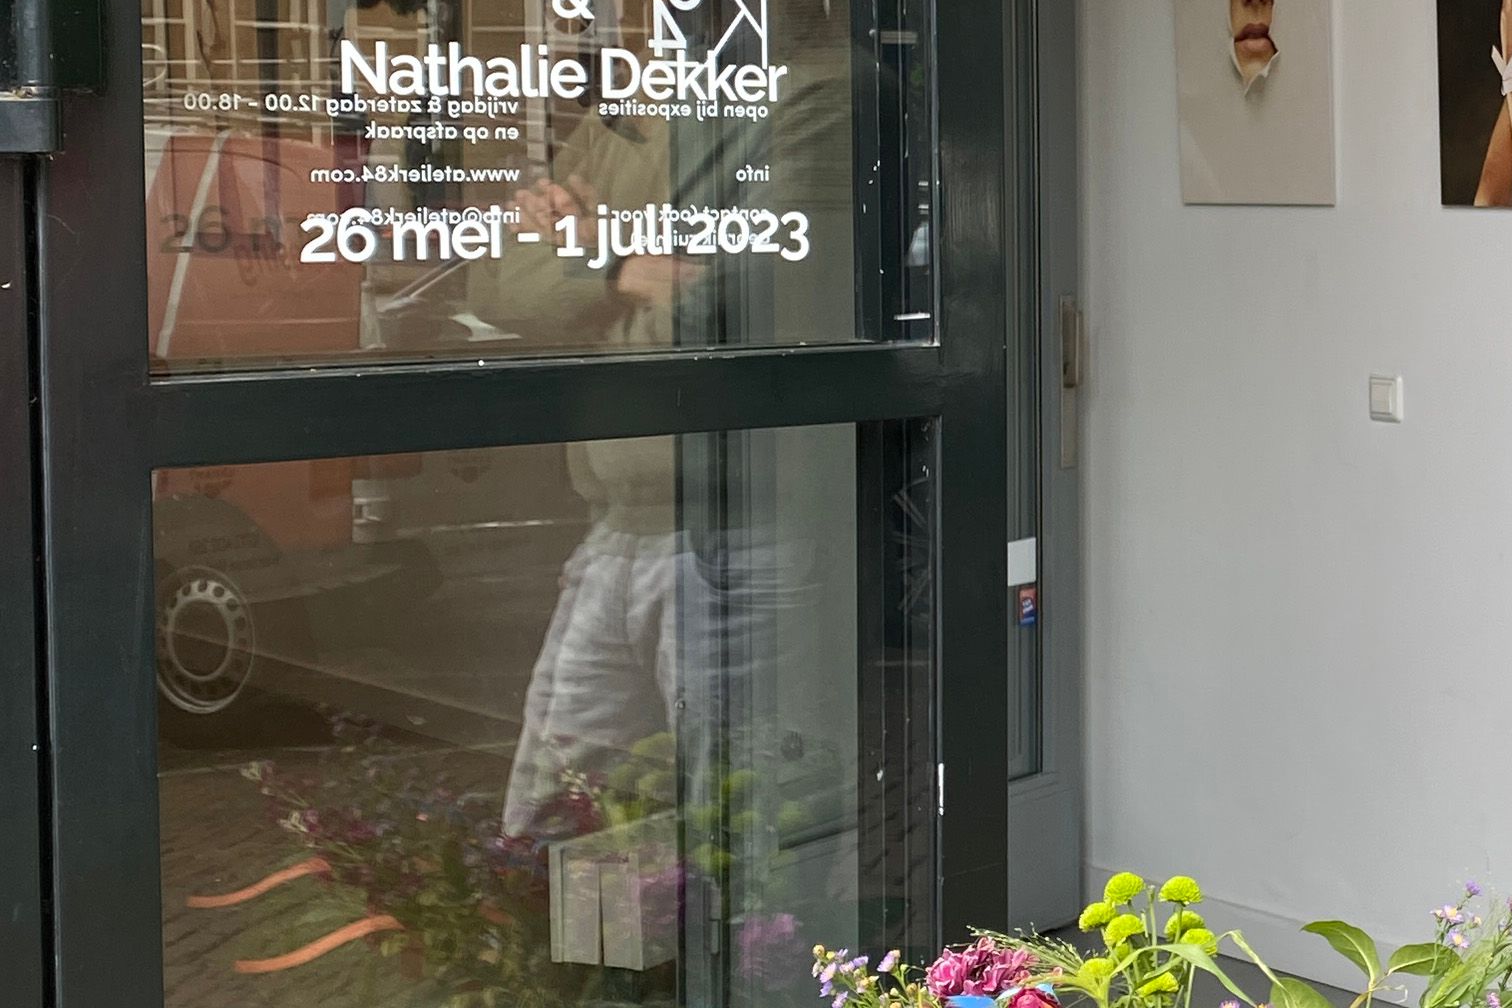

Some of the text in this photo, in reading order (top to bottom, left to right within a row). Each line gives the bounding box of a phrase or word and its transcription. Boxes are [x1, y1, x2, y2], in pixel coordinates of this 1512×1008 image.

[340, 38, 788, 102] Nathalie Dekker
[300, 207, 378, 264] 26
[392, 203, 502, 261] mei
[517, 232, 540, 244] -
[554, 214, 585, 258] 1
[586, 202, 673, 270] juli
[686, 210, 811, 262] 2023
